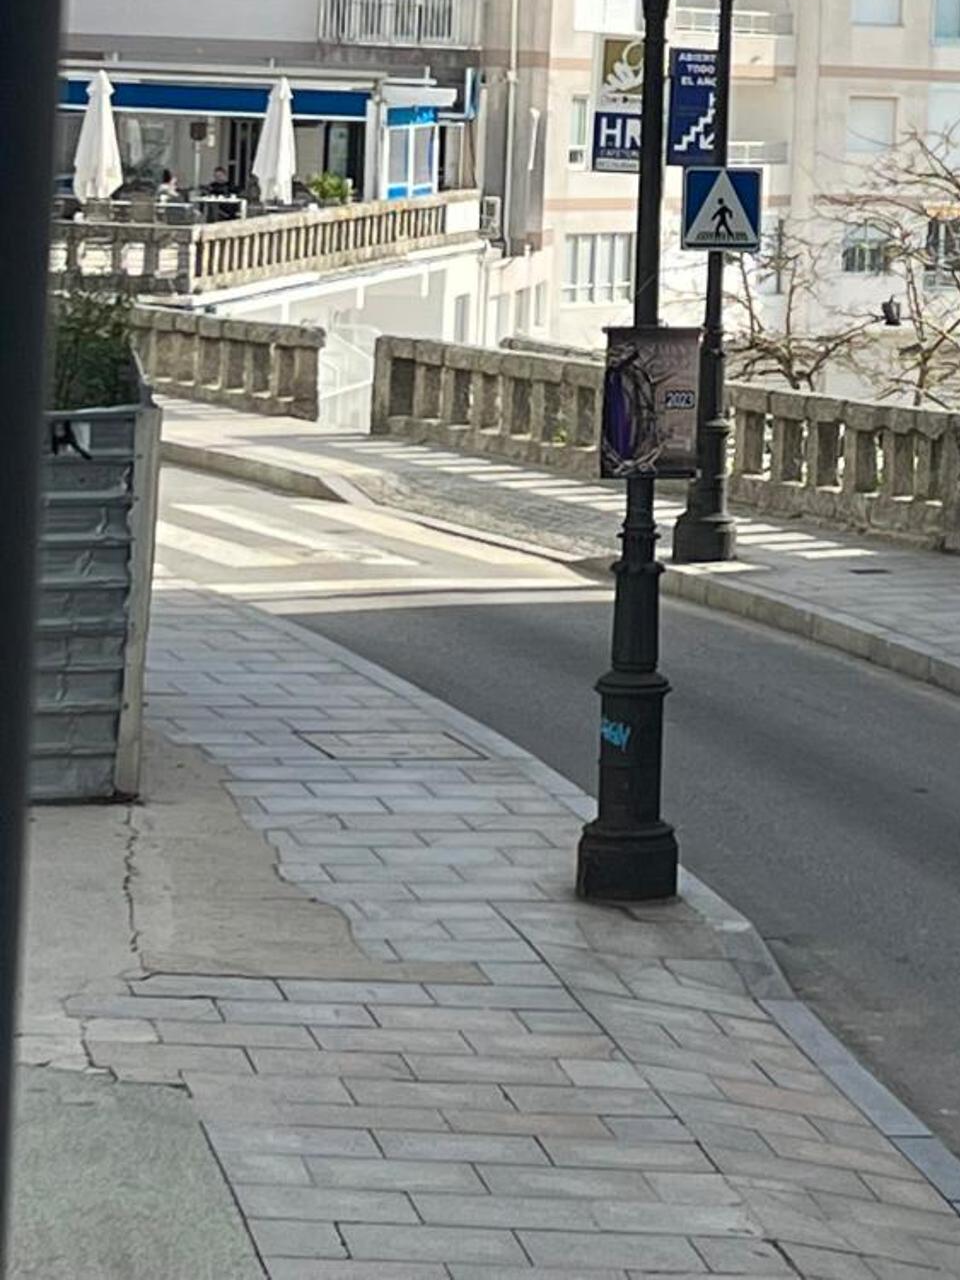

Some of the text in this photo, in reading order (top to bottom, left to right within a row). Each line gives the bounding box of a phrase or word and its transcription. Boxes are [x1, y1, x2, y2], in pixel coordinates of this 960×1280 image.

[678, 52, 717, 63] ABIERT
[686, 64, 716, 74] TODO
[681, 75, 695, 86] EL
